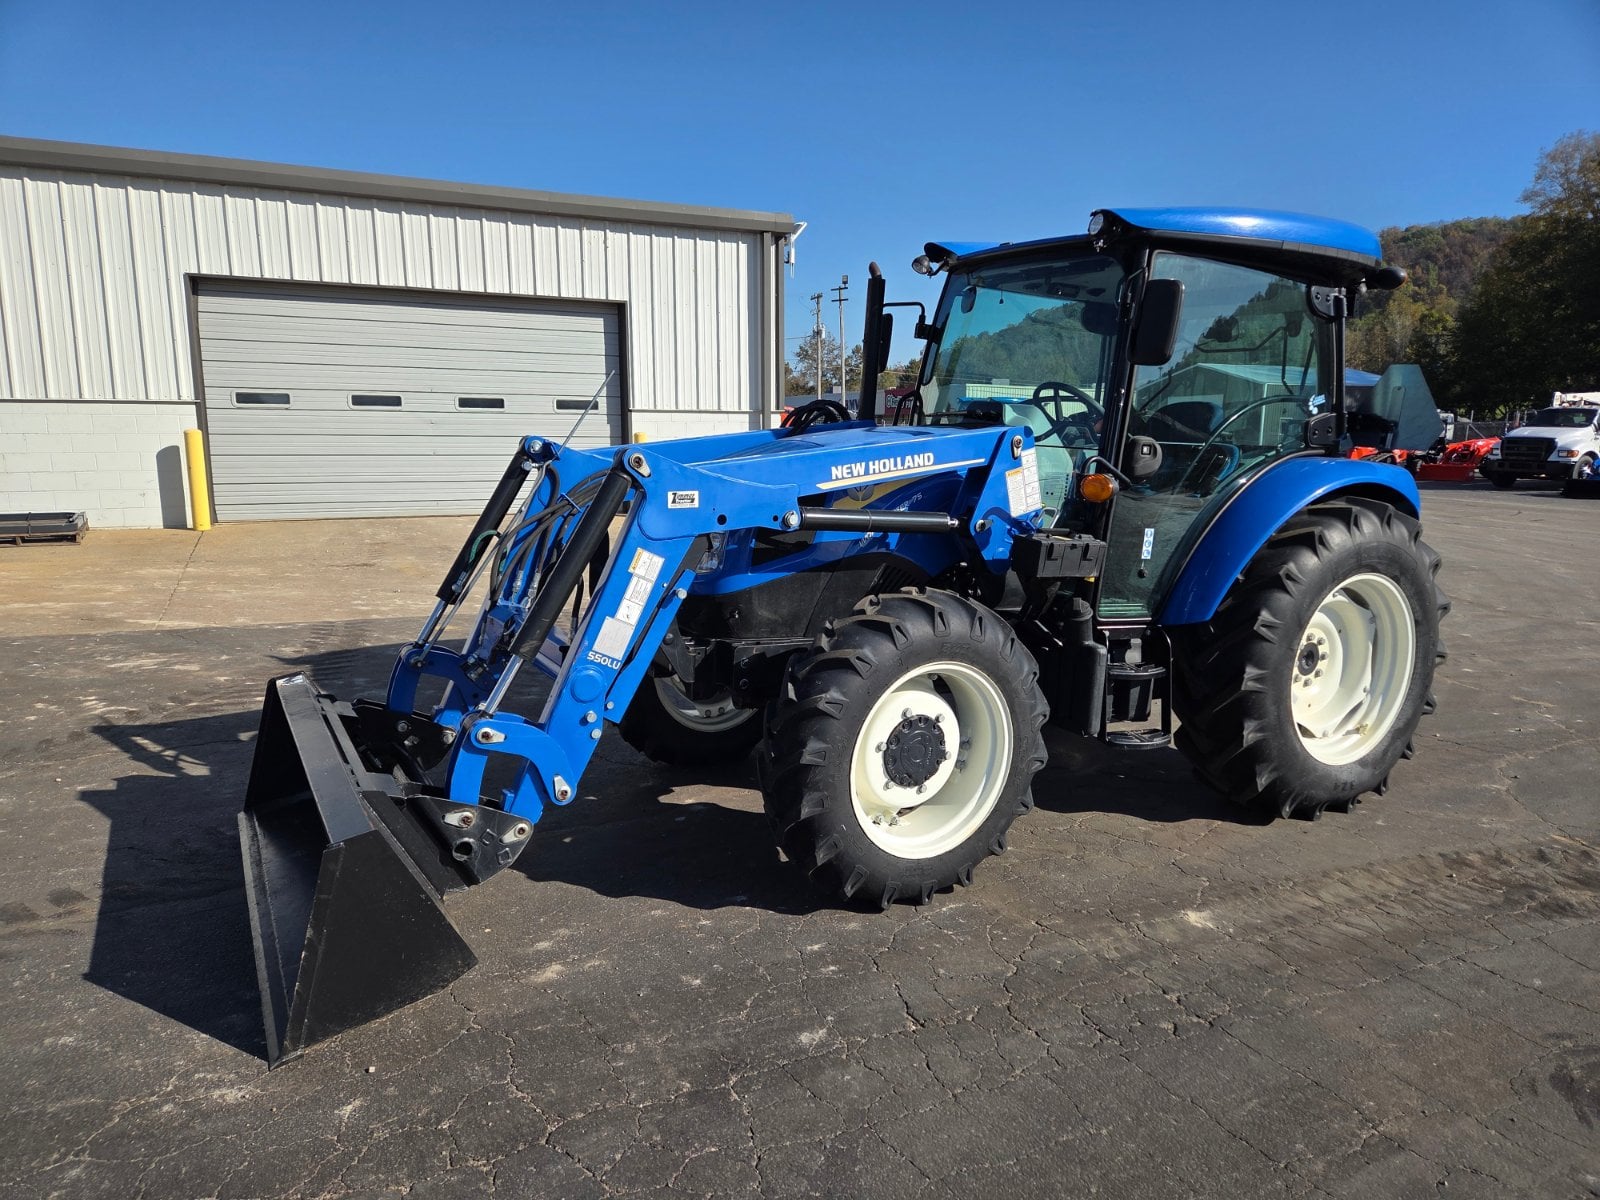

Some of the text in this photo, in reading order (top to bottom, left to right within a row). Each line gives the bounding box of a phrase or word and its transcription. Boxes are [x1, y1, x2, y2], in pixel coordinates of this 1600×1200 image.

[831, 452, 934, 480] NEW HOLLAND
[586, 651, 621, 670] 550LU
